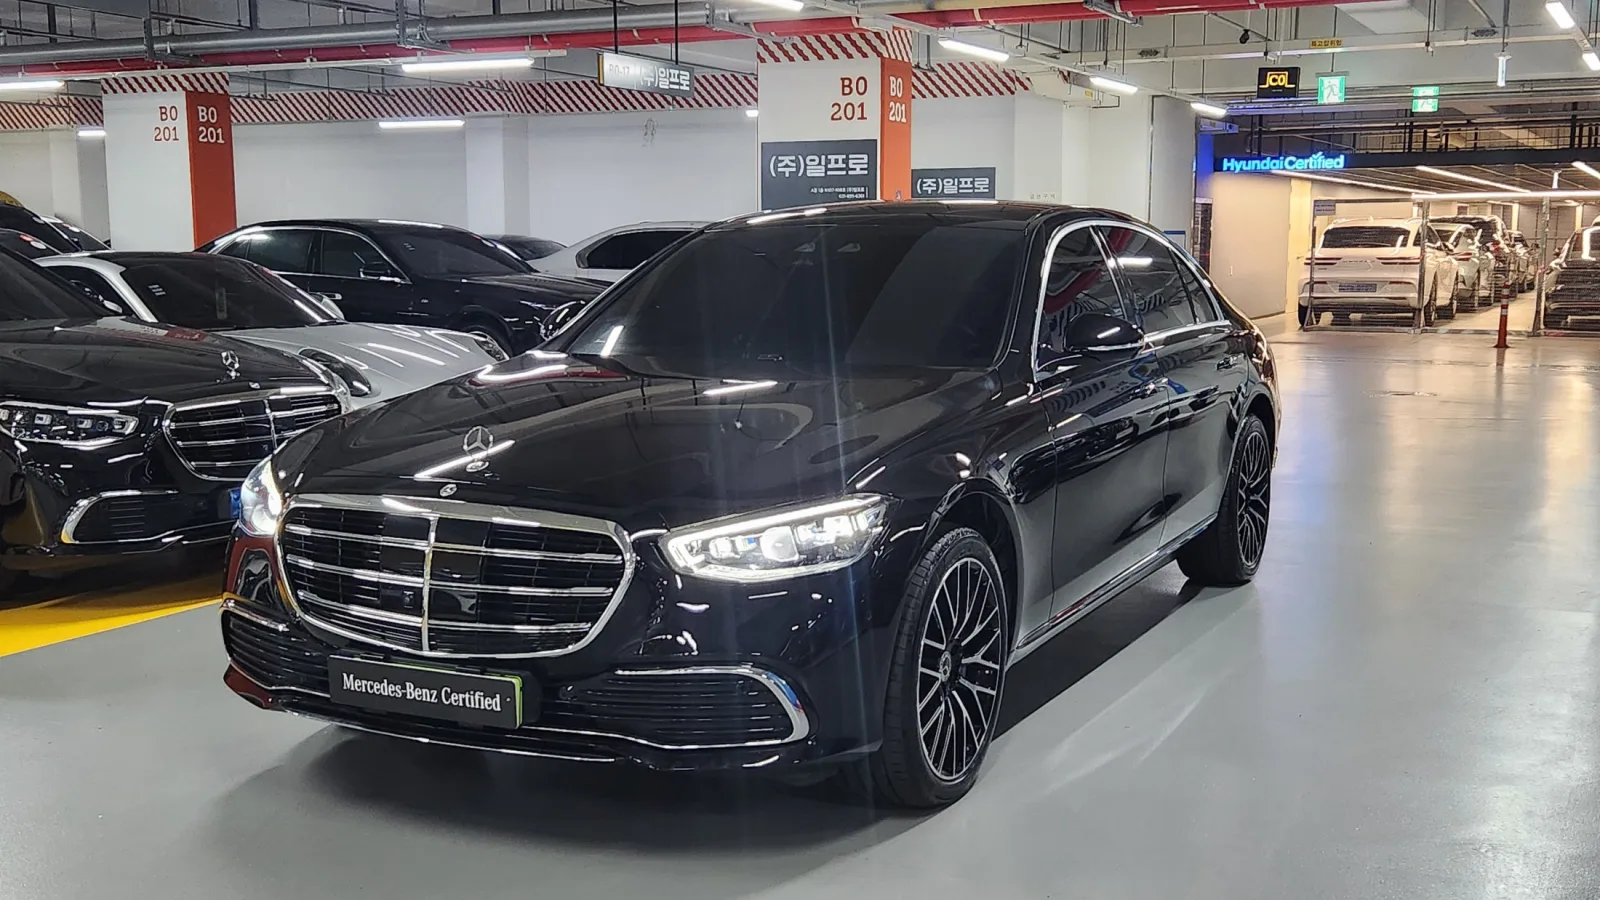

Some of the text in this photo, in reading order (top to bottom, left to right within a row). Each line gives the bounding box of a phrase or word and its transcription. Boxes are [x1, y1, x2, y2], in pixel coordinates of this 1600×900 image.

[830, 102, 867, 121] 201
[889, 101, 907, 123] 201
[154, 127, 179, 141] 201
[199, 127, 225, 143] 201
[770, 154, 869, 177] (주)일프로
[1222, 153, 1345, 173] Hyundai Certified
[917, 177, 989, 194] (주)일프로
[342, 672, 502, 712] Mercedes-Benz Certified
